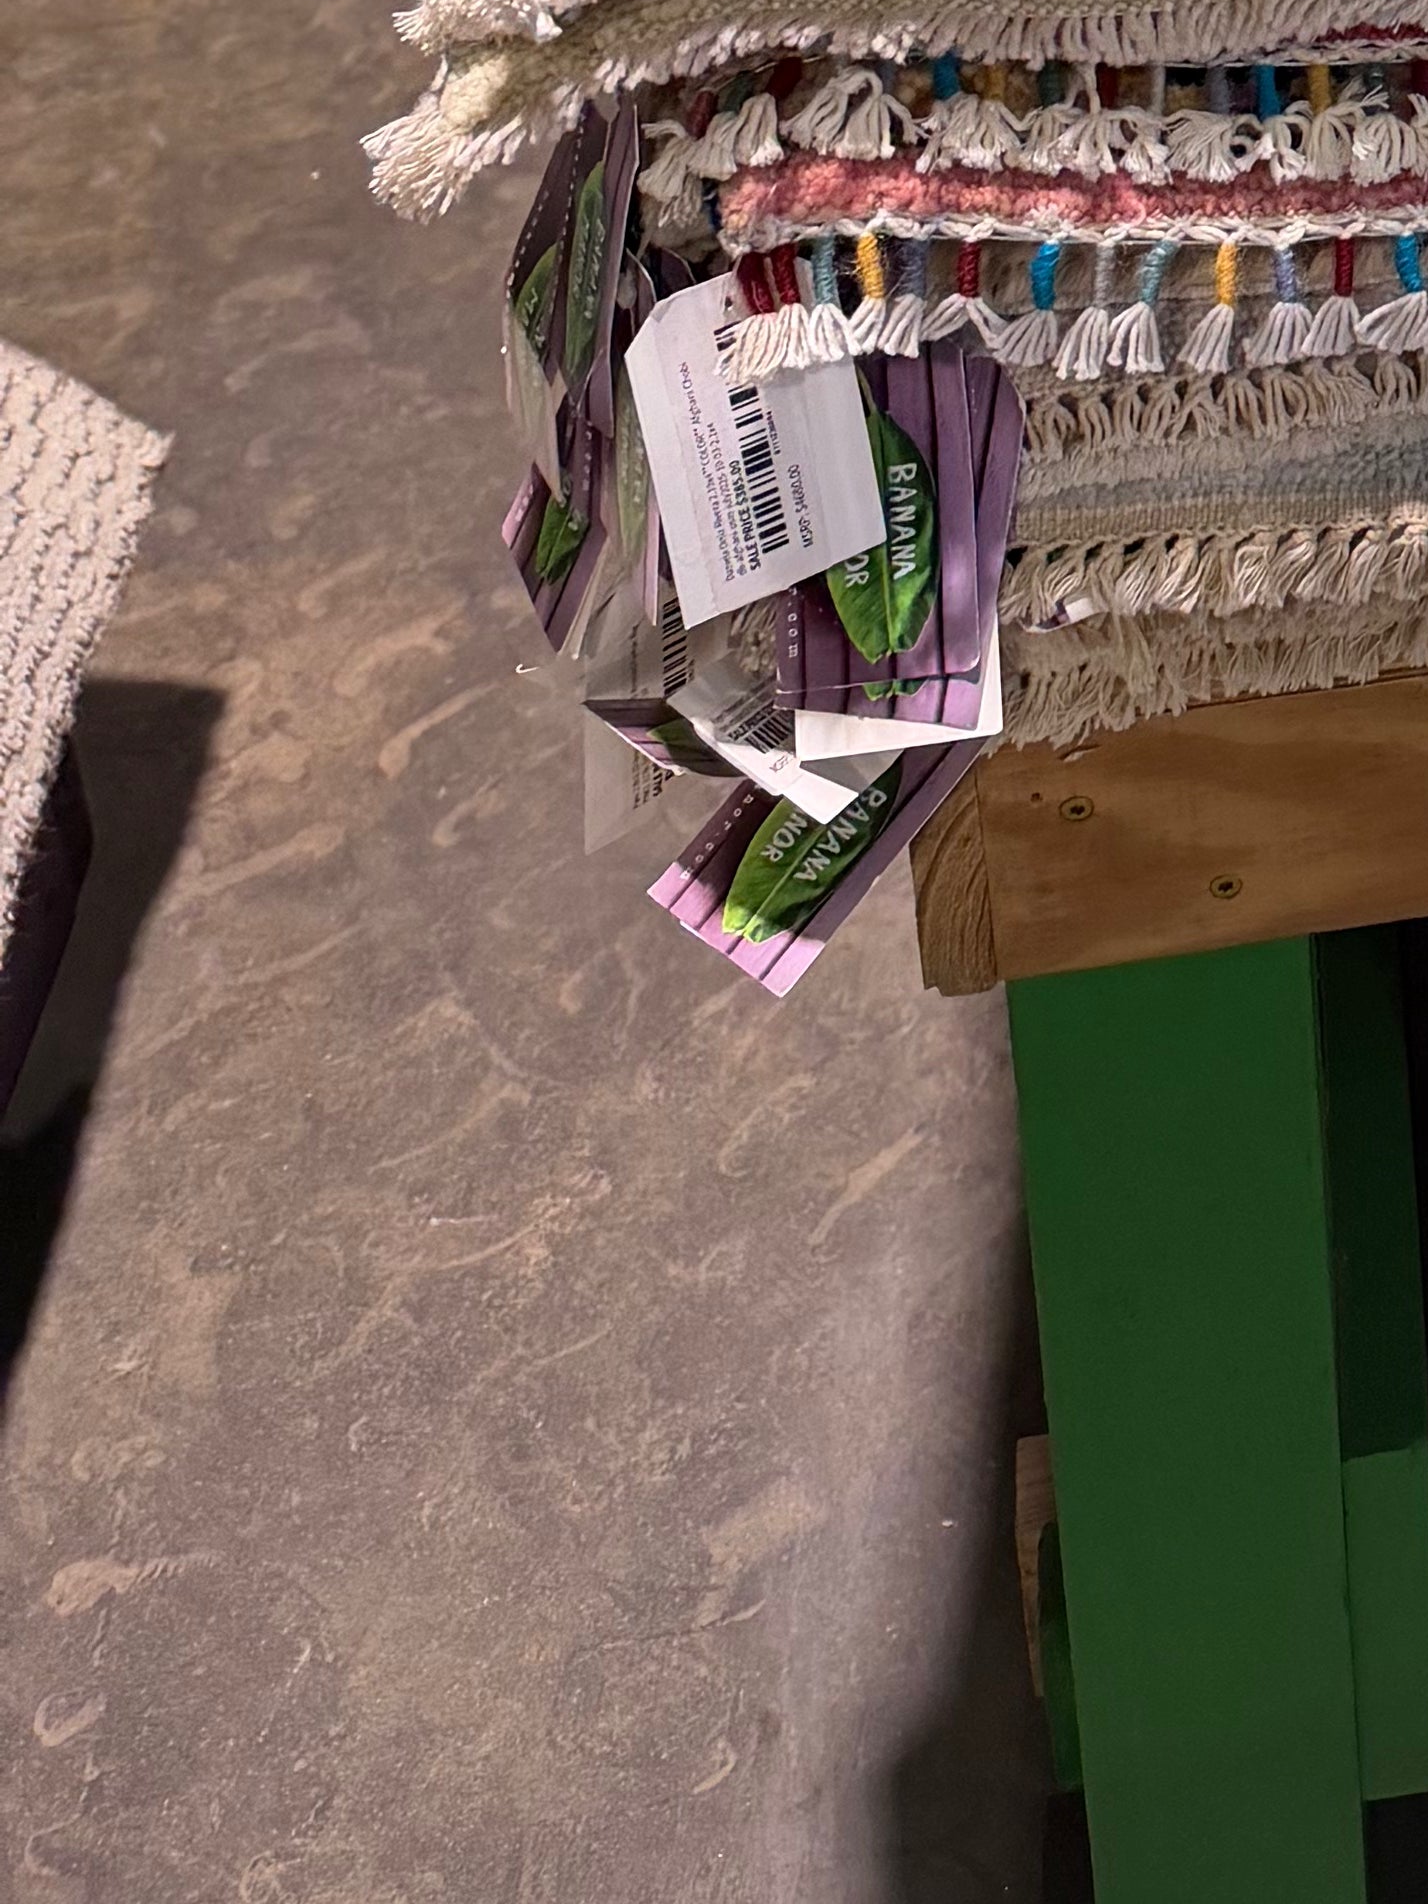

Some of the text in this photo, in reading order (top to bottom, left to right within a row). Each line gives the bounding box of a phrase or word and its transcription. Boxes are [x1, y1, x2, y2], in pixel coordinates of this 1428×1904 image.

[728, 459, 761, 571] SALE PRICE $385.00
[889, 463, 917, 580] BANANA
[761, 811, 808, 862] NOR
[794, 786, 886, 882] BANANA
